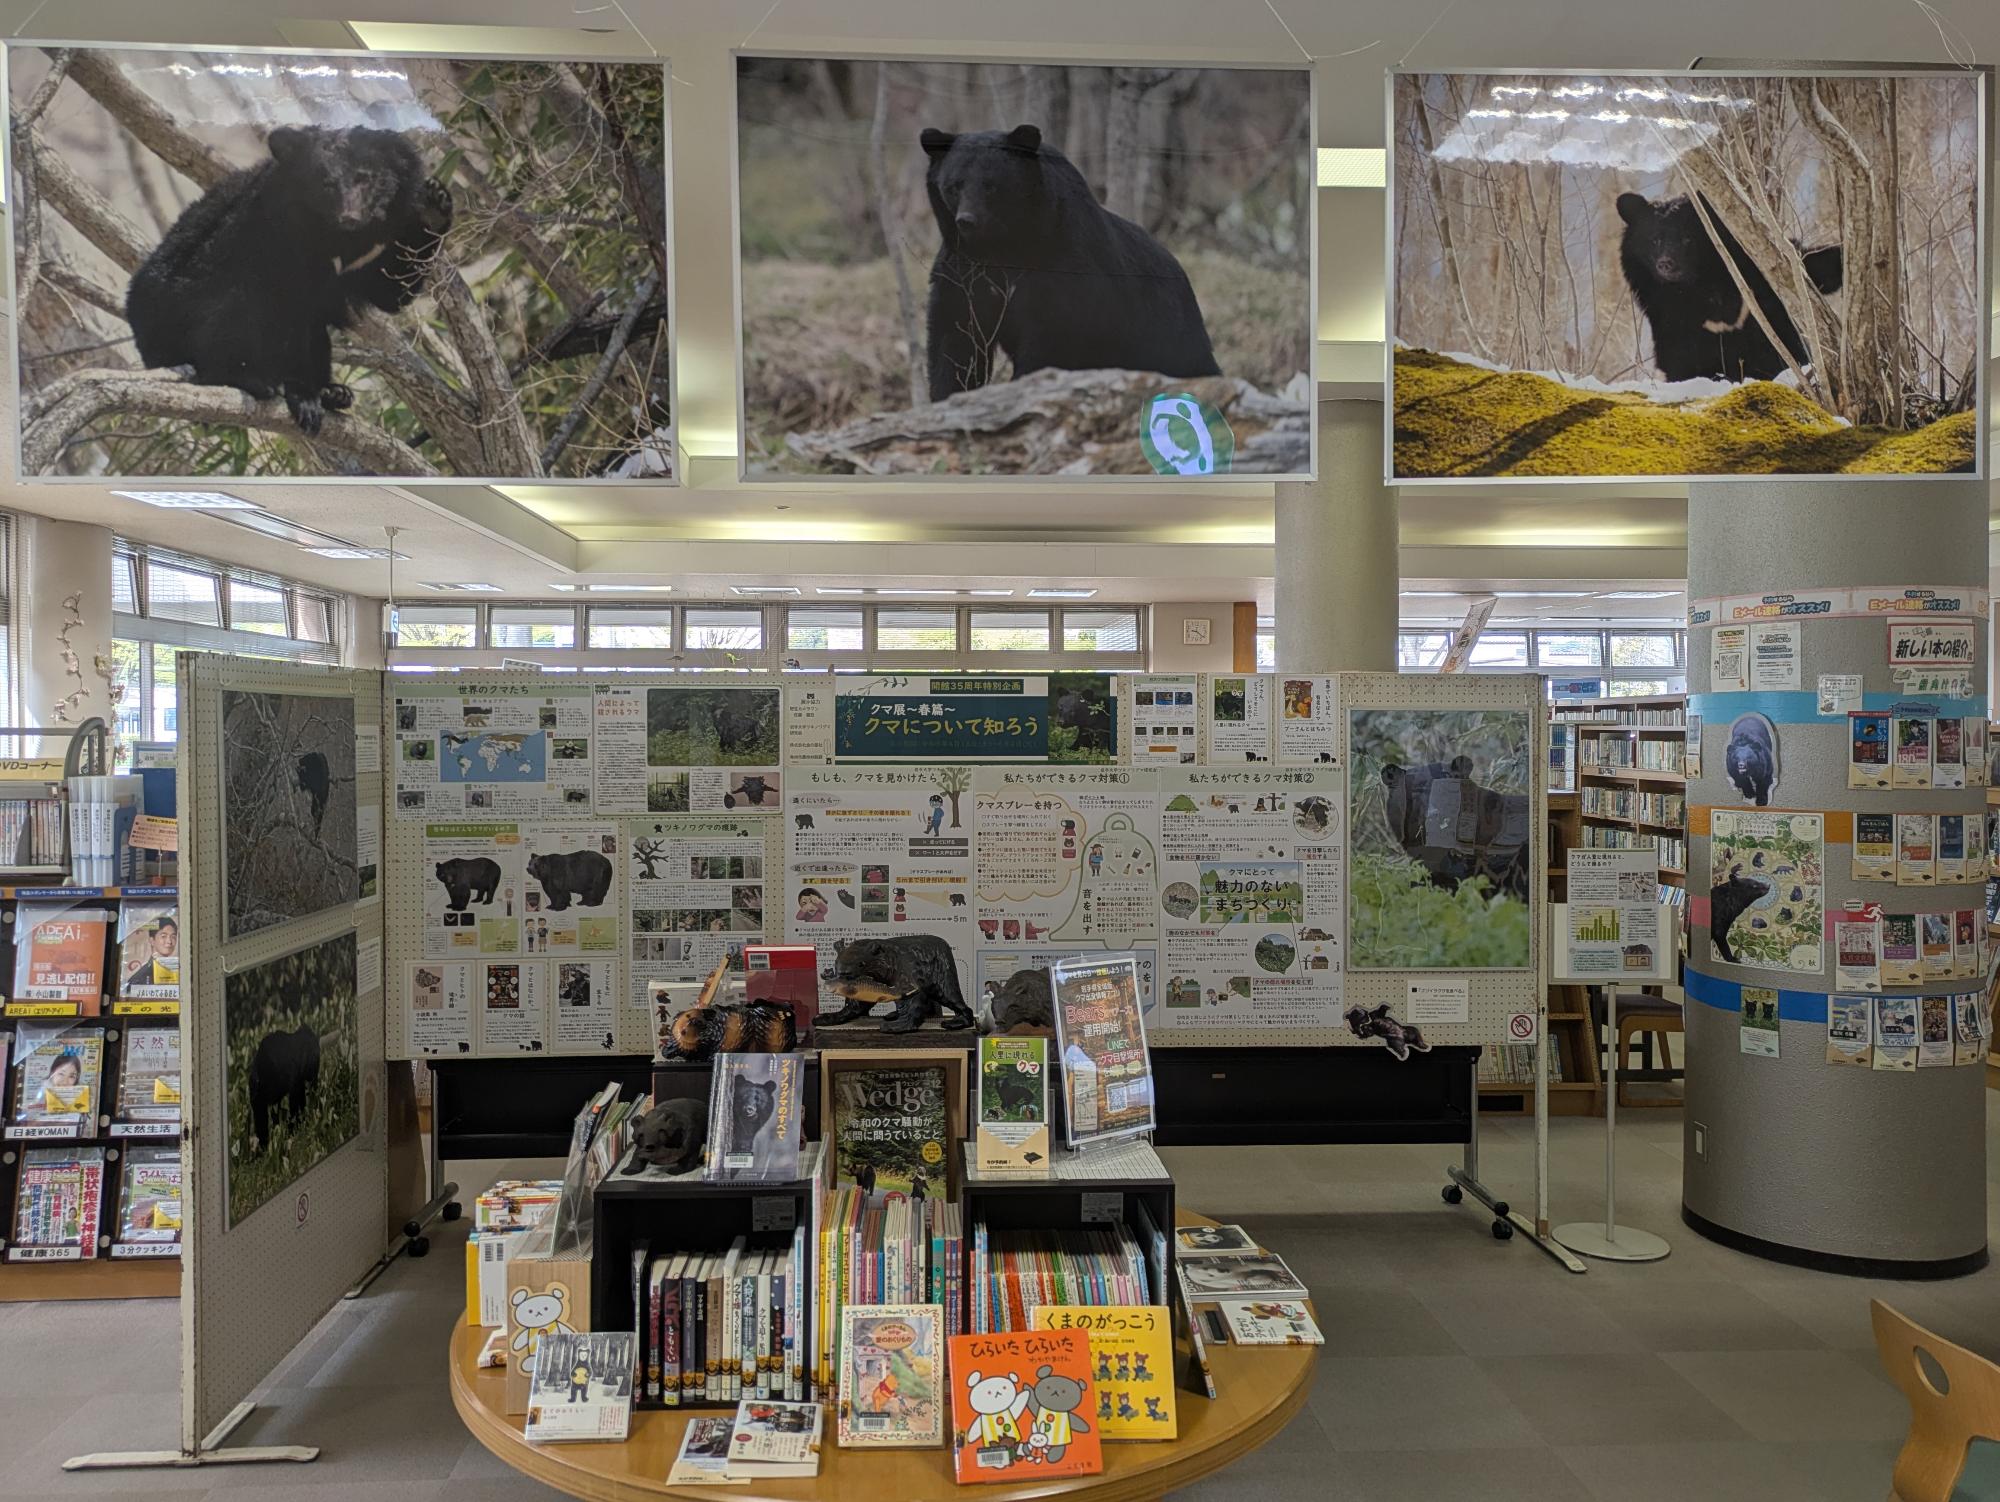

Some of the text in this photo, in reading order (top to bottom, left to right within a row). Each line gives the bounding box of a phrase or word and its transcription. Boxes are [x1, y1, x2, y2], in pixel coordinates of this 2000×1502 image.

[1895, 638, 1969, 658] 新しい本の紹介
[458, 685, 529, 695] 世界のクマたち
[931, 680, 1021, 692] 開館35周年特別企画
[864, 717, 1039, 736] クマについて知ろう
[0, 762, 64, 771] VDコーナー
[1003, 772, 1130, 784] 私たちができるクマ対策①
[1188, 772, 1315, 784] 私たちができるクマ対策②
[976, 801, 1062, 810] クマスプレーを持つ
[665, 823, 738, 832] ツキノワグマの痕跡
[1229, 868, 1275, 876] クマにとって
[1215, 880, 1289, 894] 魅力のない
[1216, 898, 1288, 912] まちづくり
[1082, 888, 1093, 936] 音を出す
[35, 973, 96, 985] 見逃し配信!!
[1065, 1005, 1105, 1024] Bears
[990, 1050, 1035, 1060] 人里に現れる
[1018, 1060, 1040, 1073] クマ
[777, 1059, 791, 1140] ツキノワグマのすべて
[842, 1081, 936, 1112] Wedge
[851, 1116, 933, 1129] 令和のクマ騒動が
[13, 1127, 70, 1137] 日経WOMAN
[120, 1125, 172, 1134] 天然生活
[843, 1130, 941, 1141] 人間に問うていること
[20, 1248, 70, 1258] 健康365
[119, 1245, 174, 1254] 3分クッキング
[1047, 1312, 1156, 1331] くまのがっこう
[970, 1336, 1074, 1358] ひらいた ひらいた
